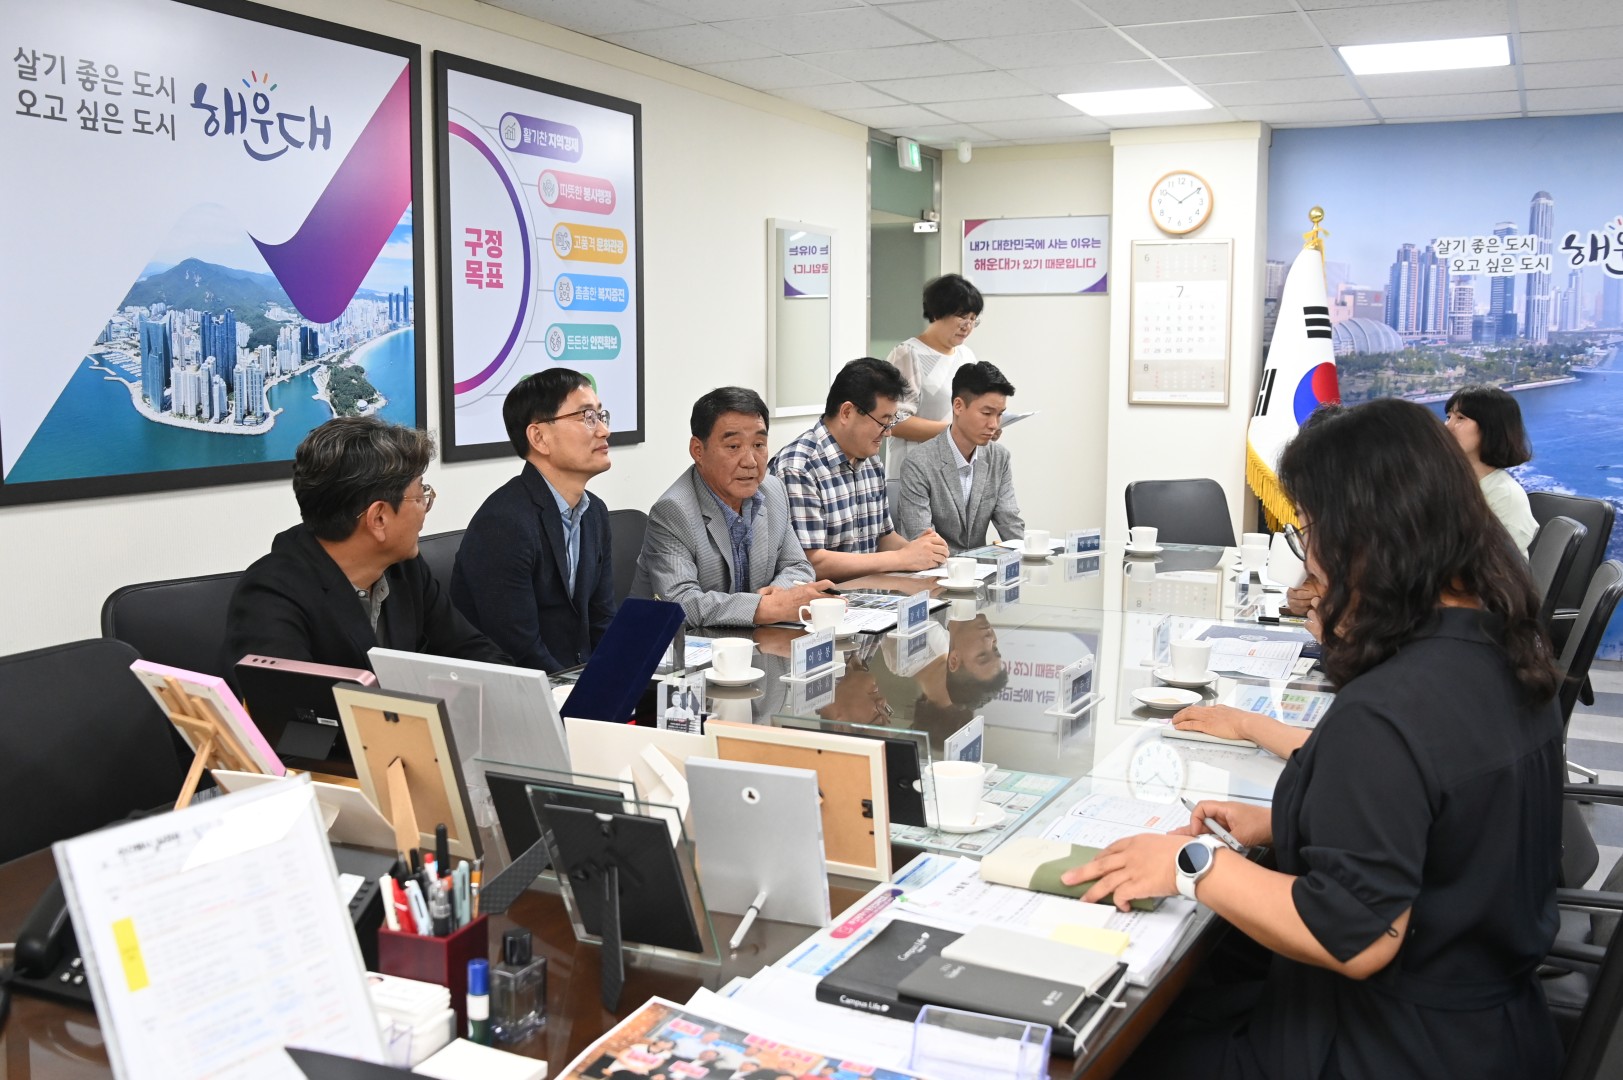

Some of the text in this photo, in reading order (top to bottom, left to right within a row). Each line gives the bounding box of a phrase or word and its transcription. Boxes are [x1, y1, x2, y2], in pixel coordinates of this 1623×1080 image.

[13, 47, 176, 104] 살기 좋은 도시
[16, 89, 176, 141] 오고 싶은 도시
[190, 82, 332, 161] 해운대
[523, 127, 579, 153] 활기찬 지역경제
[1178, 177, 1186, 185] 12
[559, 183, 612, 205] 따뜻한 봉사행정
[1157, 198, 1163, 206] 9
[1160, 208, 1165, 217] 8
[1167, 216, 1172, 224] 7
[1188, 216, 1193, 224] 5
[1177, 219, 1182, 227] 6
[465, 228, 503, 259] 구정
[574, 235, 596, 252] 고품격
[970, 237, 1101, 252] 내가 대한민국에 사는 이유는
[1437, 237, 1534, 254] 살기 좋은 도시
[974, 257, 1097, 271] 해운대가 있기 때문입니다
[1144, 253, 1150, 262] 6
[1452, 257, 1549, 273] 오고 싶은 도시
[465, 260, 504, 290] 목표
[575, 286, 597, 301] 촘촘한
[1176, 285, 1184, 298] 7
[567, 335, 618, 350] 든든한 안전확보
[1143, 363, 1149, 372] 8
[840, 994, 882, 1011] Campus Life
